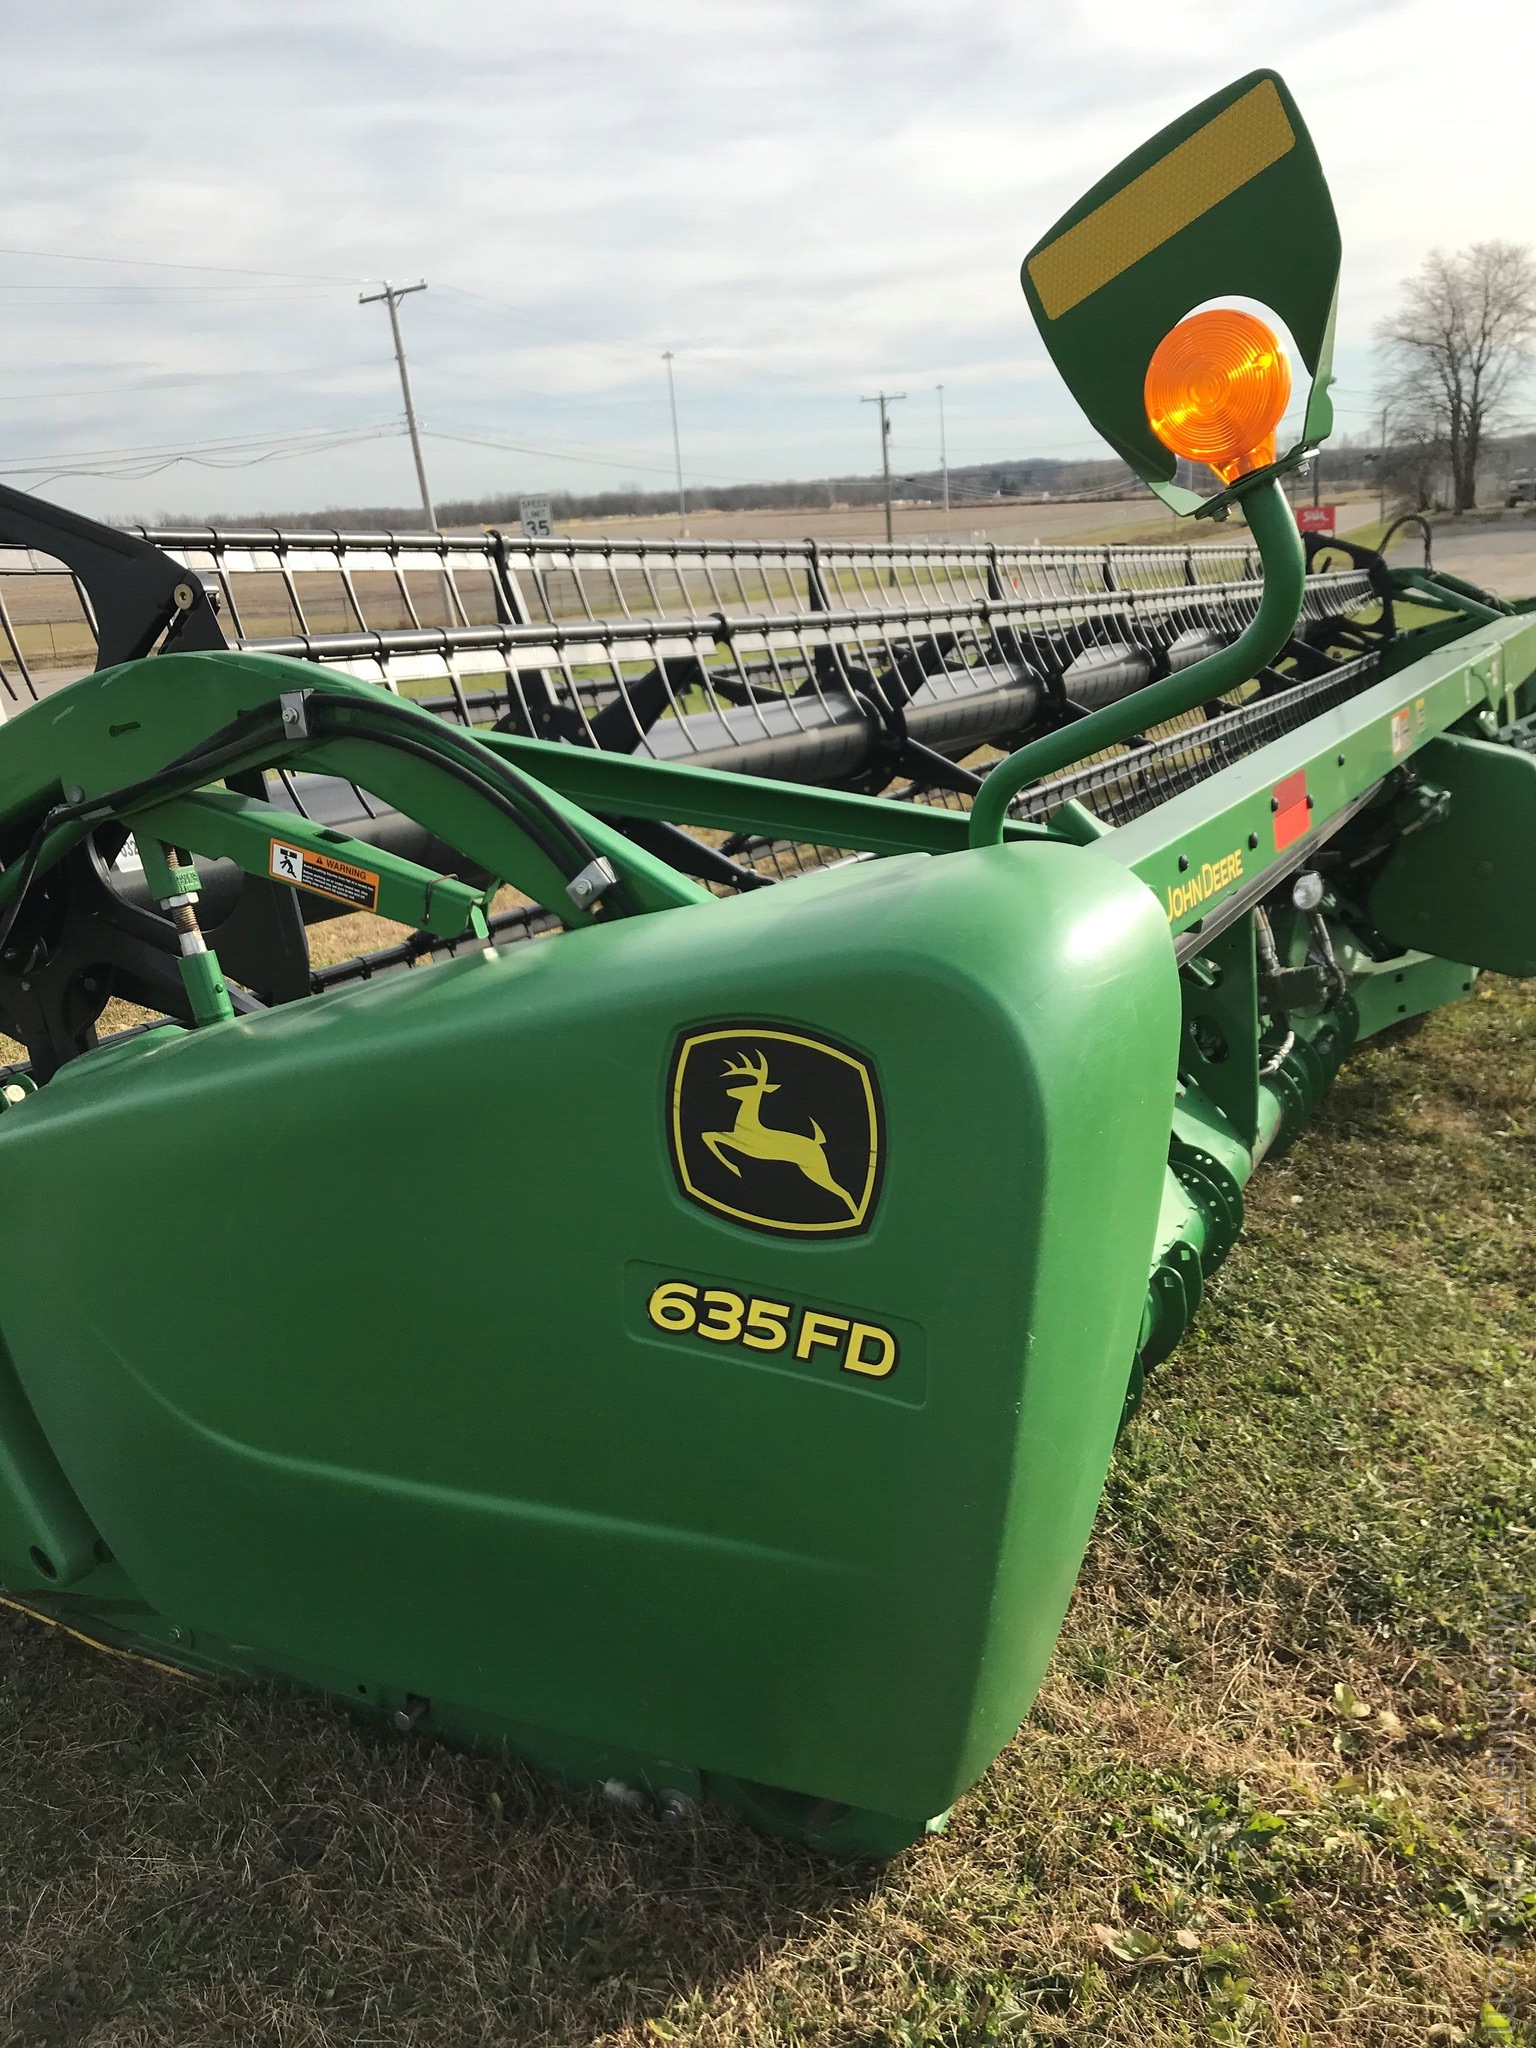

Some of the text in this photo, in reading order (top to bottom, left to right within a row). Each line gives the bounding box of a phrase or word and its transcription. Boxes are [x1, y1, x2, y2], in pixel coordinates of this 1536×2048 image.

[521, 500, 550, 509] SPEED
[527, 509, 547, 518] LIMIT
[526, 519, 551, 536] 35
[326, 858, 367, 880] WARNING
